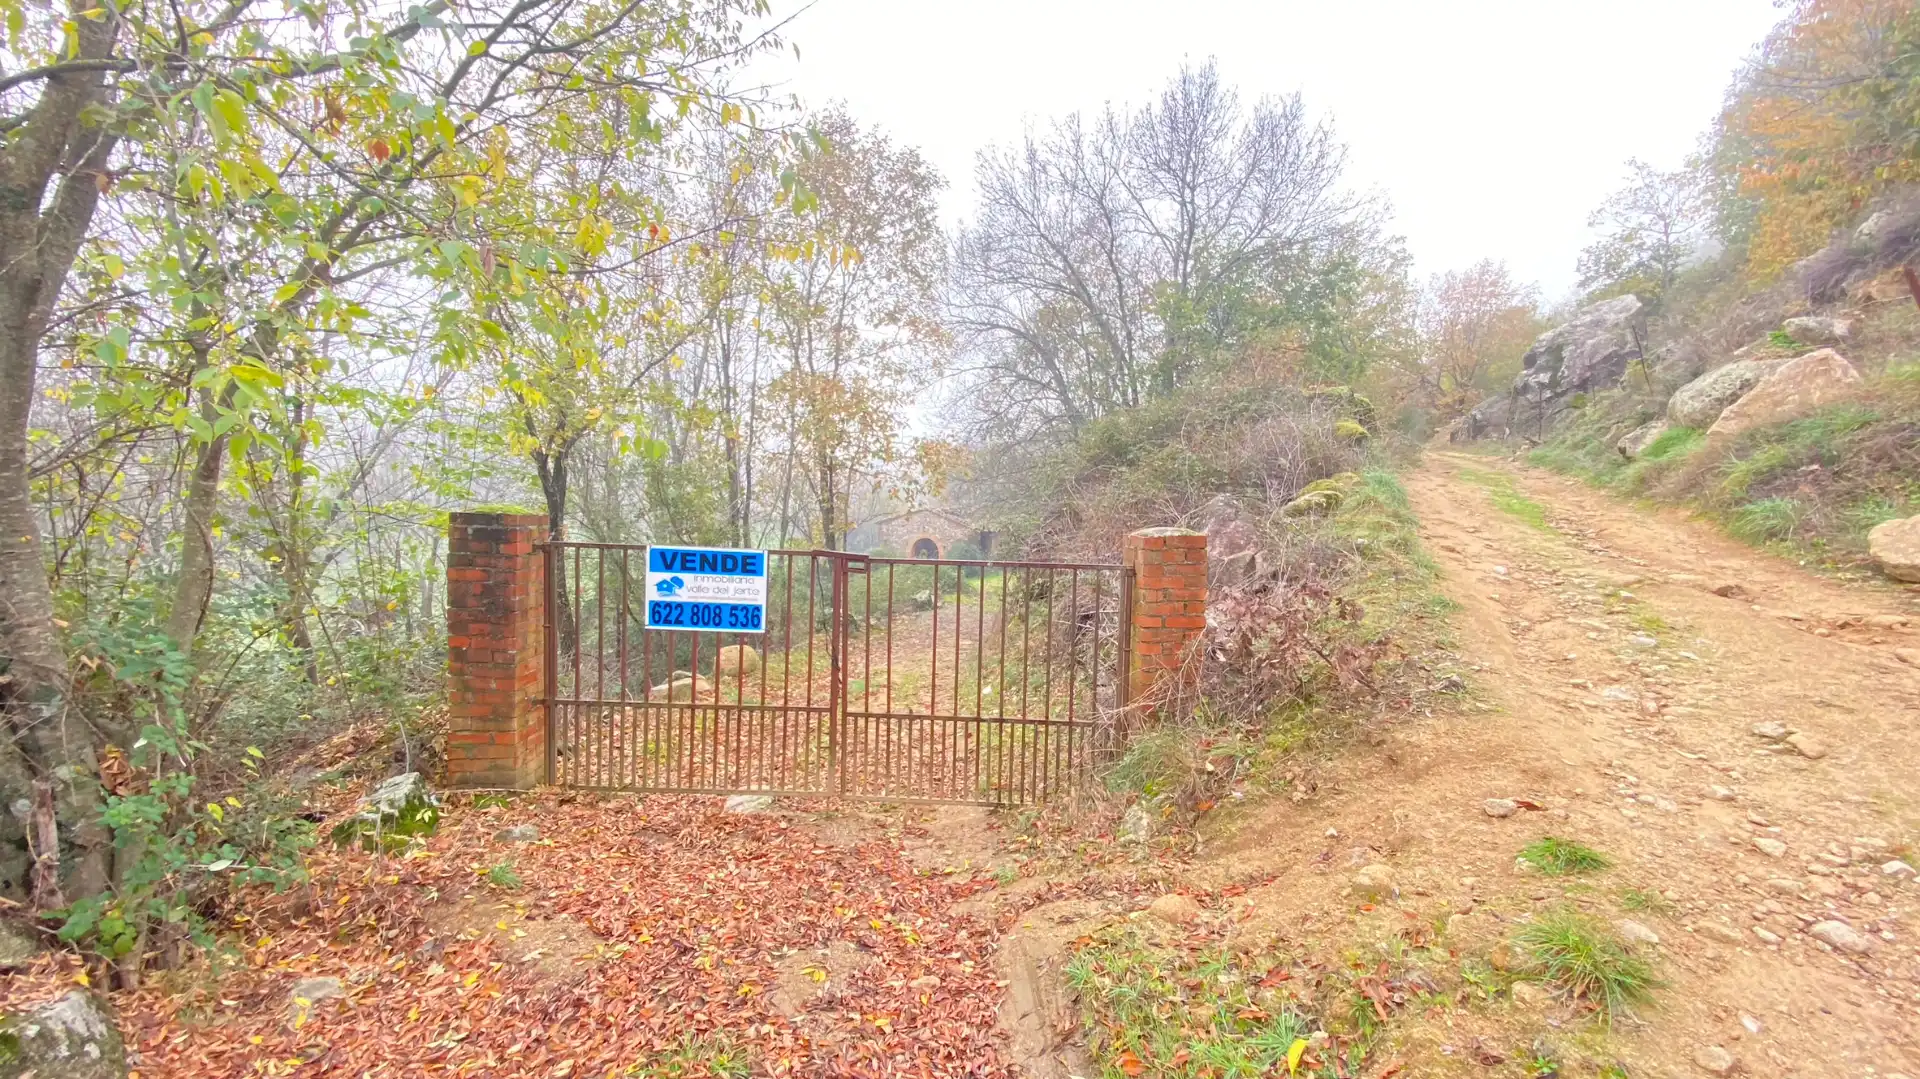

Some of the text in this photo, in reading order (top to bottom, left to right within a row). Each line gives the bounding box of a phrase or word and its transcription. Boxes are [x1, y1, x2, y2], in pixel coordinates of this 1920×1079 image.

[659, 551, 757, 574] VENDE
[712, 585, 729, 595] del
[651, 601, 761, 629] 622 808 536
